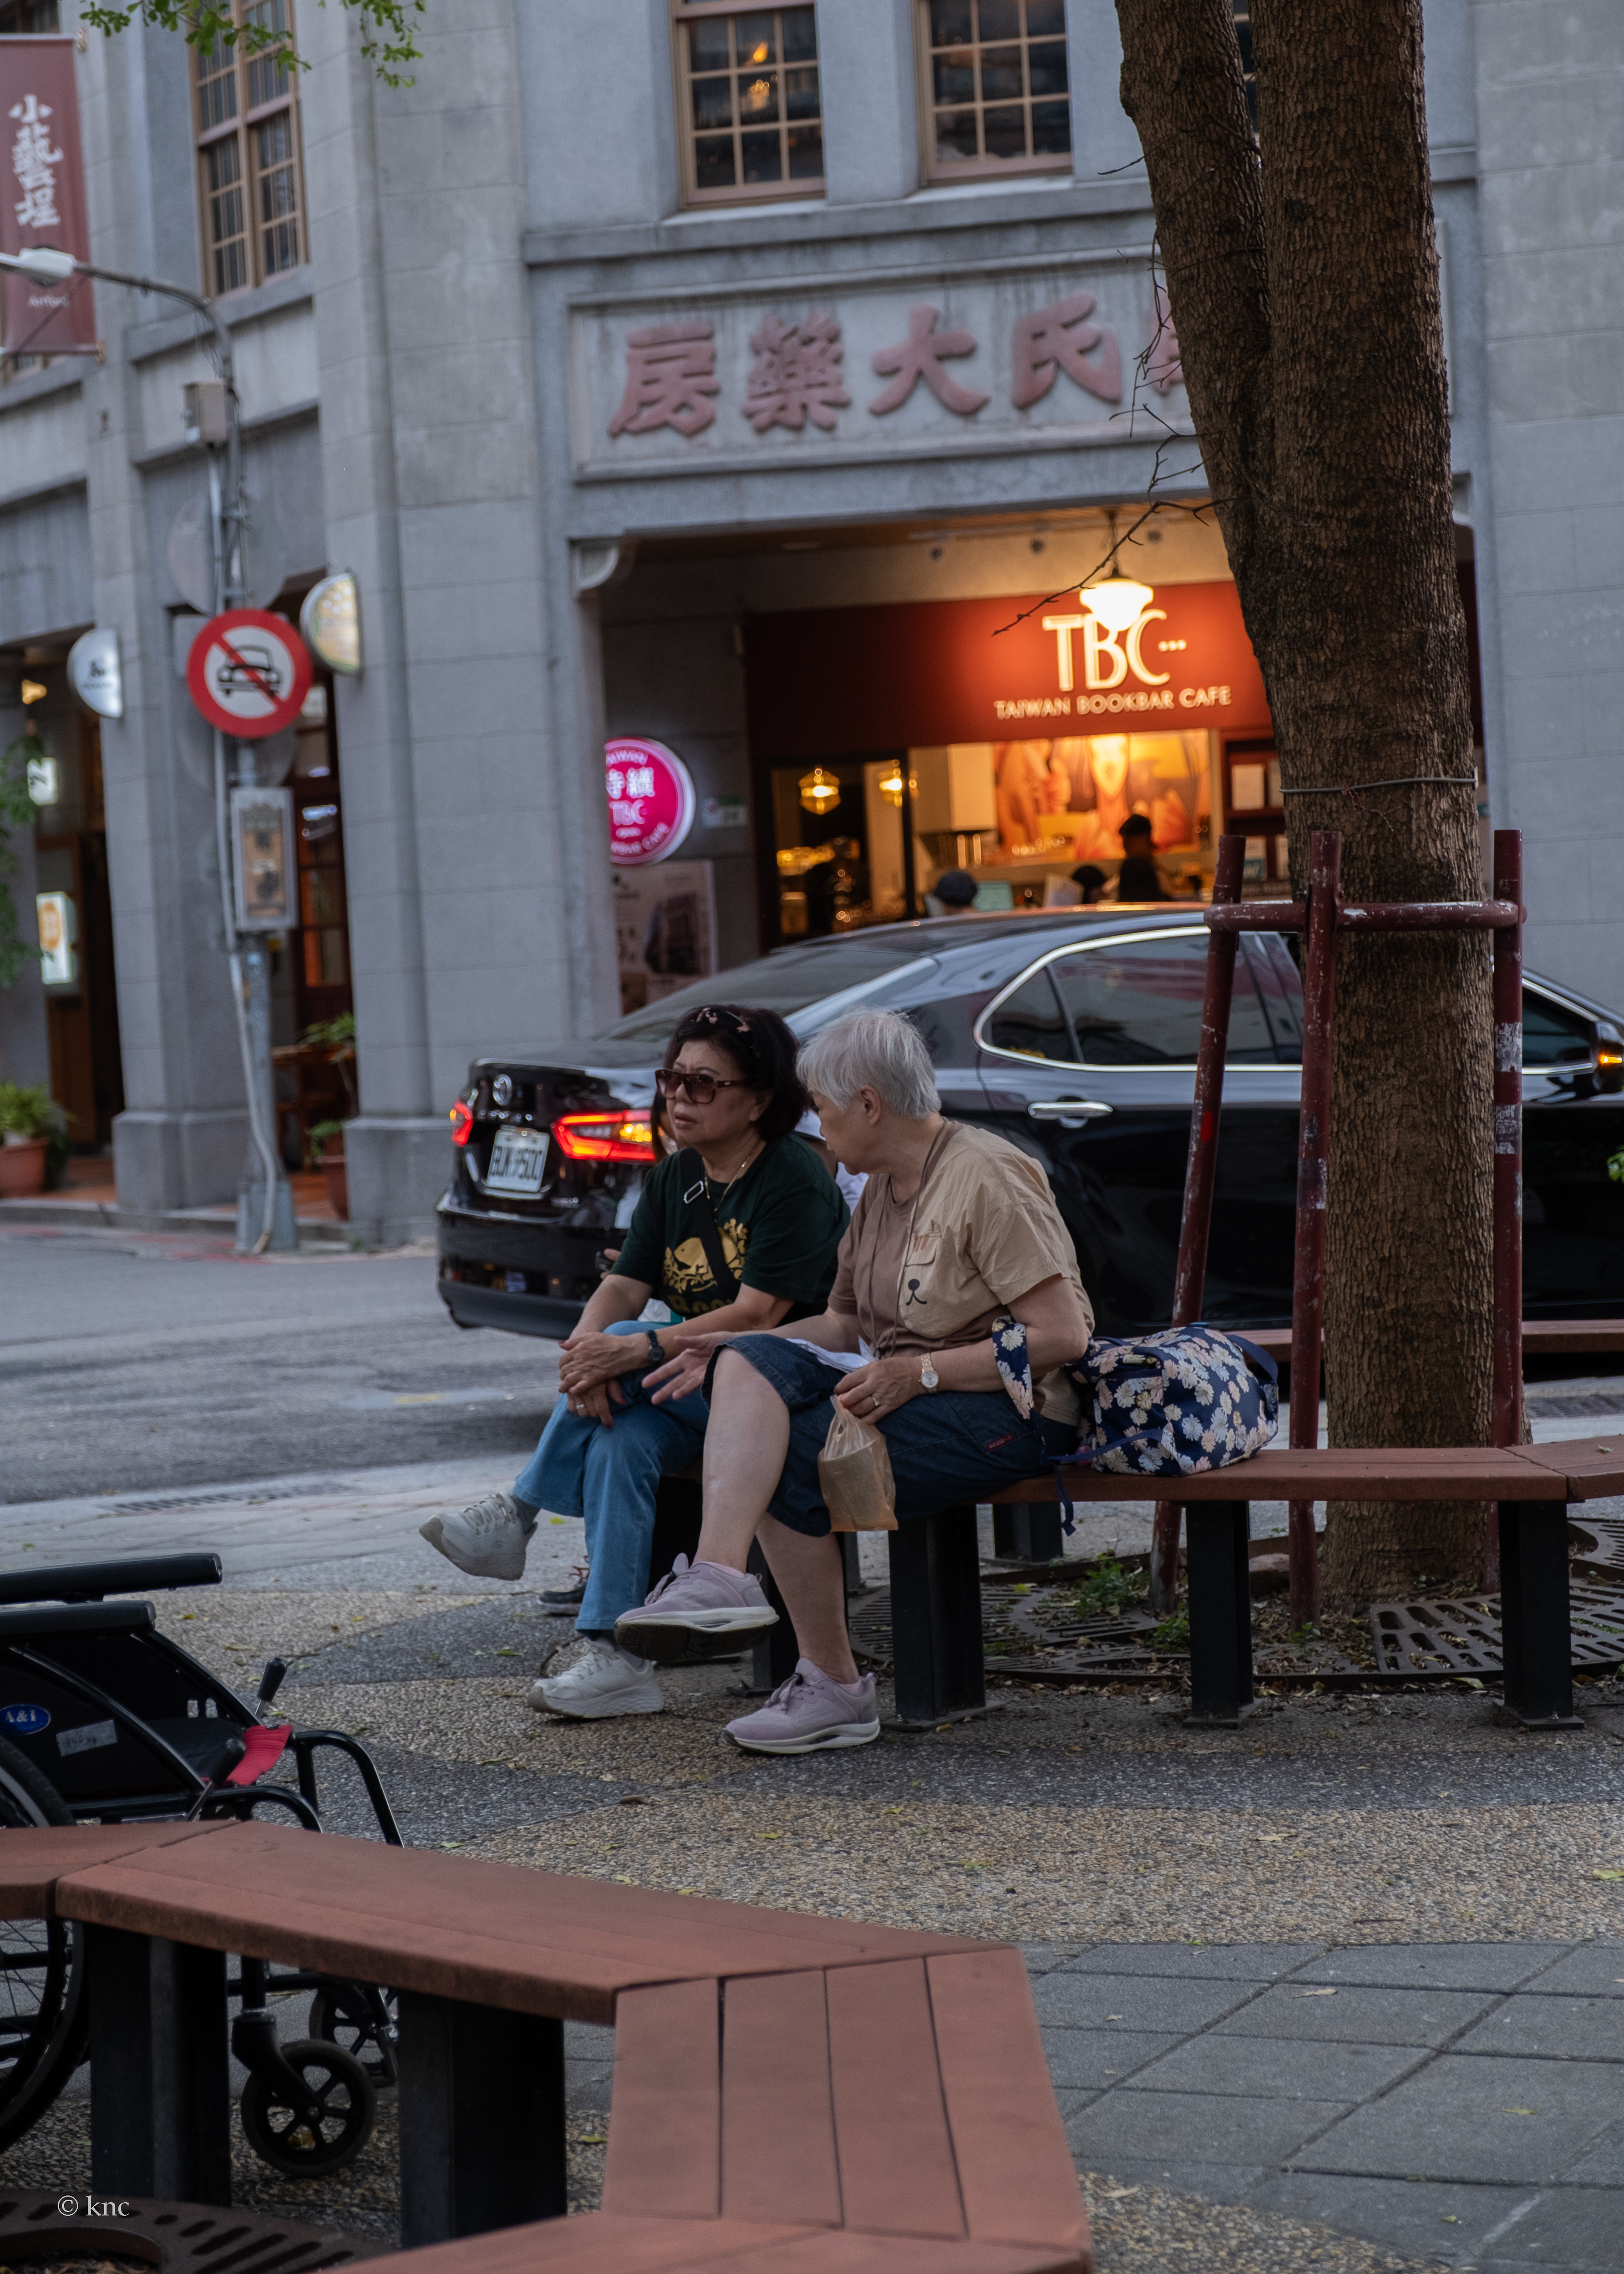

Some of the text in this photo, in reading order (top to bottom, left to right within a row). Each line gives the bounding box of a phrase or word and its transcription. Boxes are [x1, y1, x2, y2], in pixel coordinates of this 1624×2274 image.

[8, 94, 63, 228] 小藝埕
[994, 685, 1231, 720] TAIWAN BOOKBAR CAFE
[4, 1709, 36, 1723] A&I
